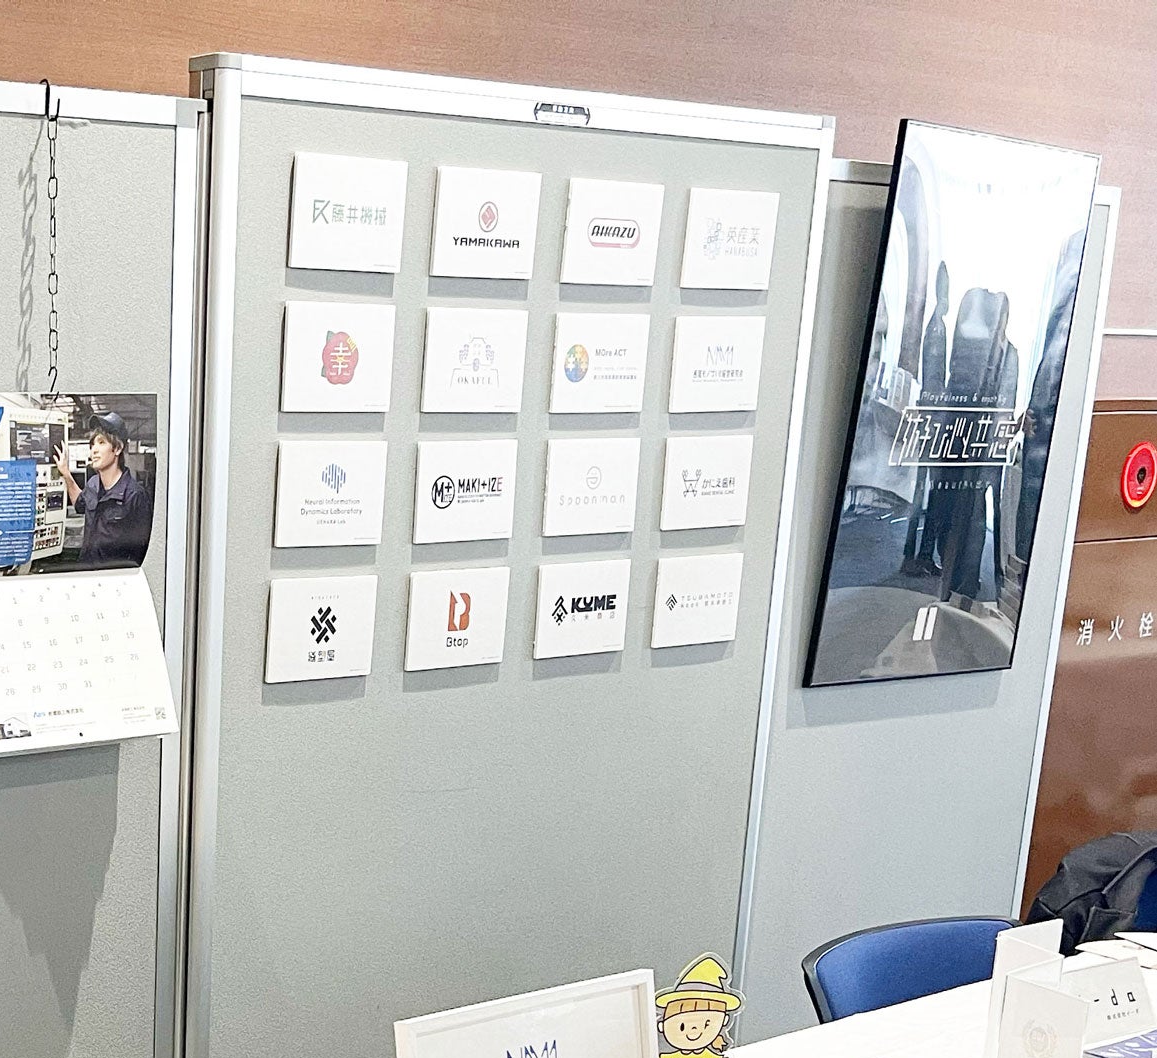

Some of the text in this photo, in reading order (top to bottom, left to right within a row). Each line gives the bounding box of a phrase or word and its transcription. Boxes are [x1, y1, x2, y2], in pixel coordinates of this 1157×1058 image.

[332, 203, 387, 226] 藤井機械
[591, 225, 636, 239] AIKAZU
[452, 236, 520, 249] YAMAKAWA
[457, 477, 504, 494] MAKI+IZE
[701, 476, 736, 489] かにえ歯科
[304, 498, 324, 506] Neural
[559, 495, 626, 506] Spoonman
[300, 507, 363, 516] Dynamics Laboratory
[570, 594, 617, 613] KUME
[1076, 612, 1154, 646] 消火栓
